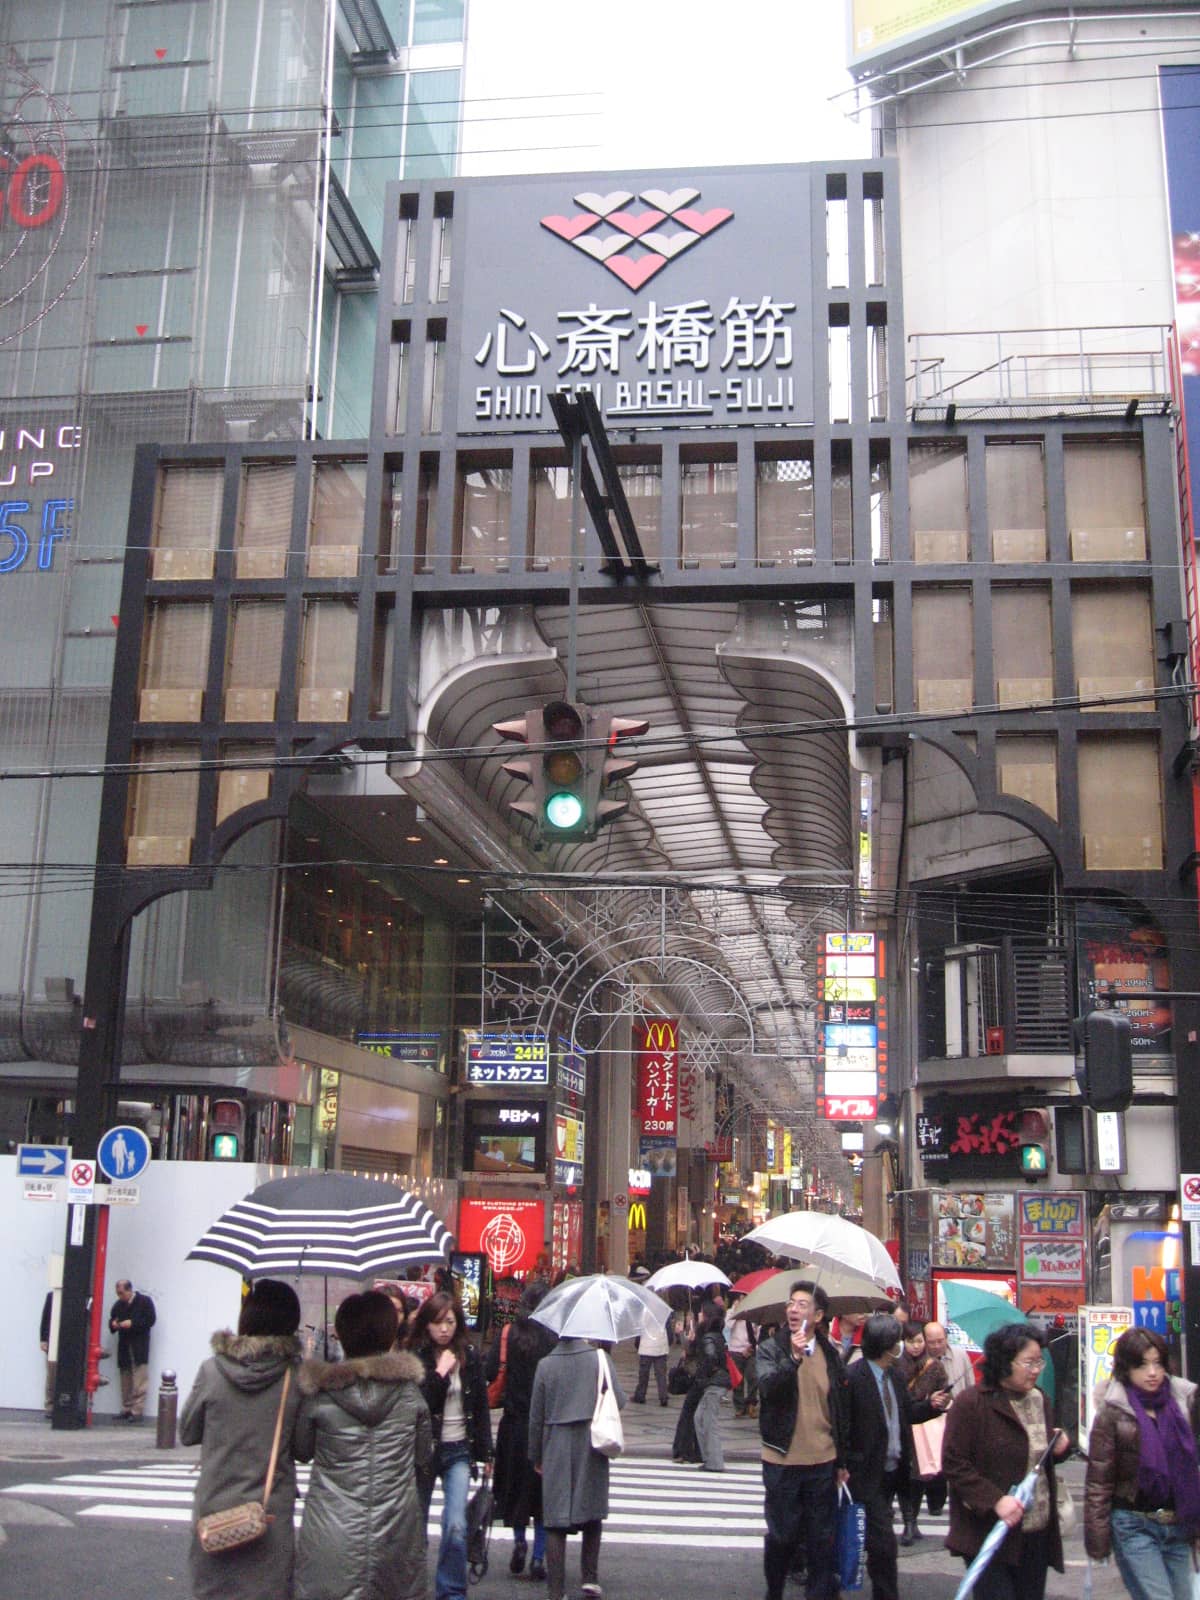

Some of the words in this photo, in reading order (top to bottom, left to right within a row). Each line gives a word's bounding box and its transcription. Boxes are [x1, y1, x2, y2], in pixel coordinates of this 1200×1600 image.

[474, 295, 797, 376] 心斎橋筋
[475, 384, 542, 418] SHIN
[514, 1045, 544, 1061] 24H
[469, 1065, 545, 1081] ネットカフェ
[660, 1051, 675, 1112] マクドナルド
[645, 1060, 660, 1118] ハンバーガー
[828, 1099, 875, 1116] アイフル
[1026, 1200, 1078, 1220] まんが
